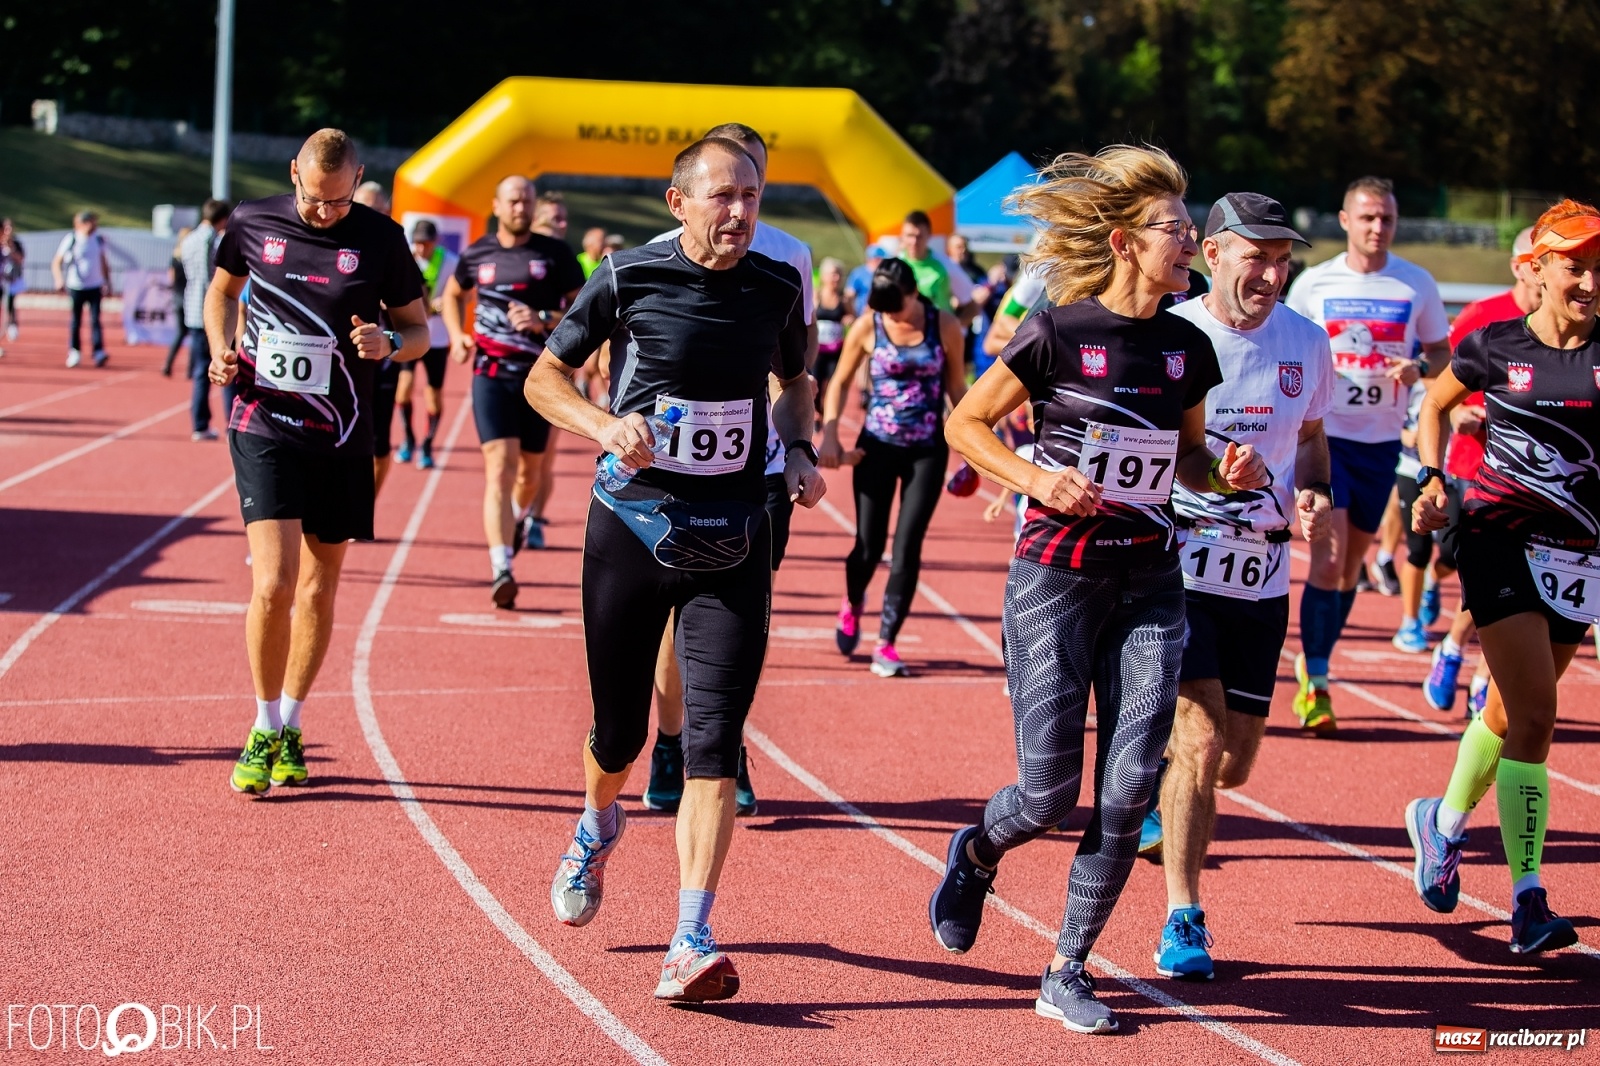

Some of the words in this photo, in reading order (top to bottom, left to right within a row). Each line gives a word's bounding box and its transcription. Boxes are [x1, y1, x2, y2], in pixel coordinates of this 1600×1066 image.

[578, 123, 661, 145] MIASTO
[269, 353, 312, 382] 30
[1347, 385, 1382, 405] 29
[693, 407, 750, 418] www.personalbest.pl
[1236, 422, 1267, 432] TorKol
[668, 426, 745, 462] 193
[1123, 436, 1176, 447] www.personalbest.pl
[1088, 451, 1172, 490] 197
[689, 516, 729, 527] Reebok
[1189, 546, 1262, 587] 116
[1540, 571, 1586, 608] 94
